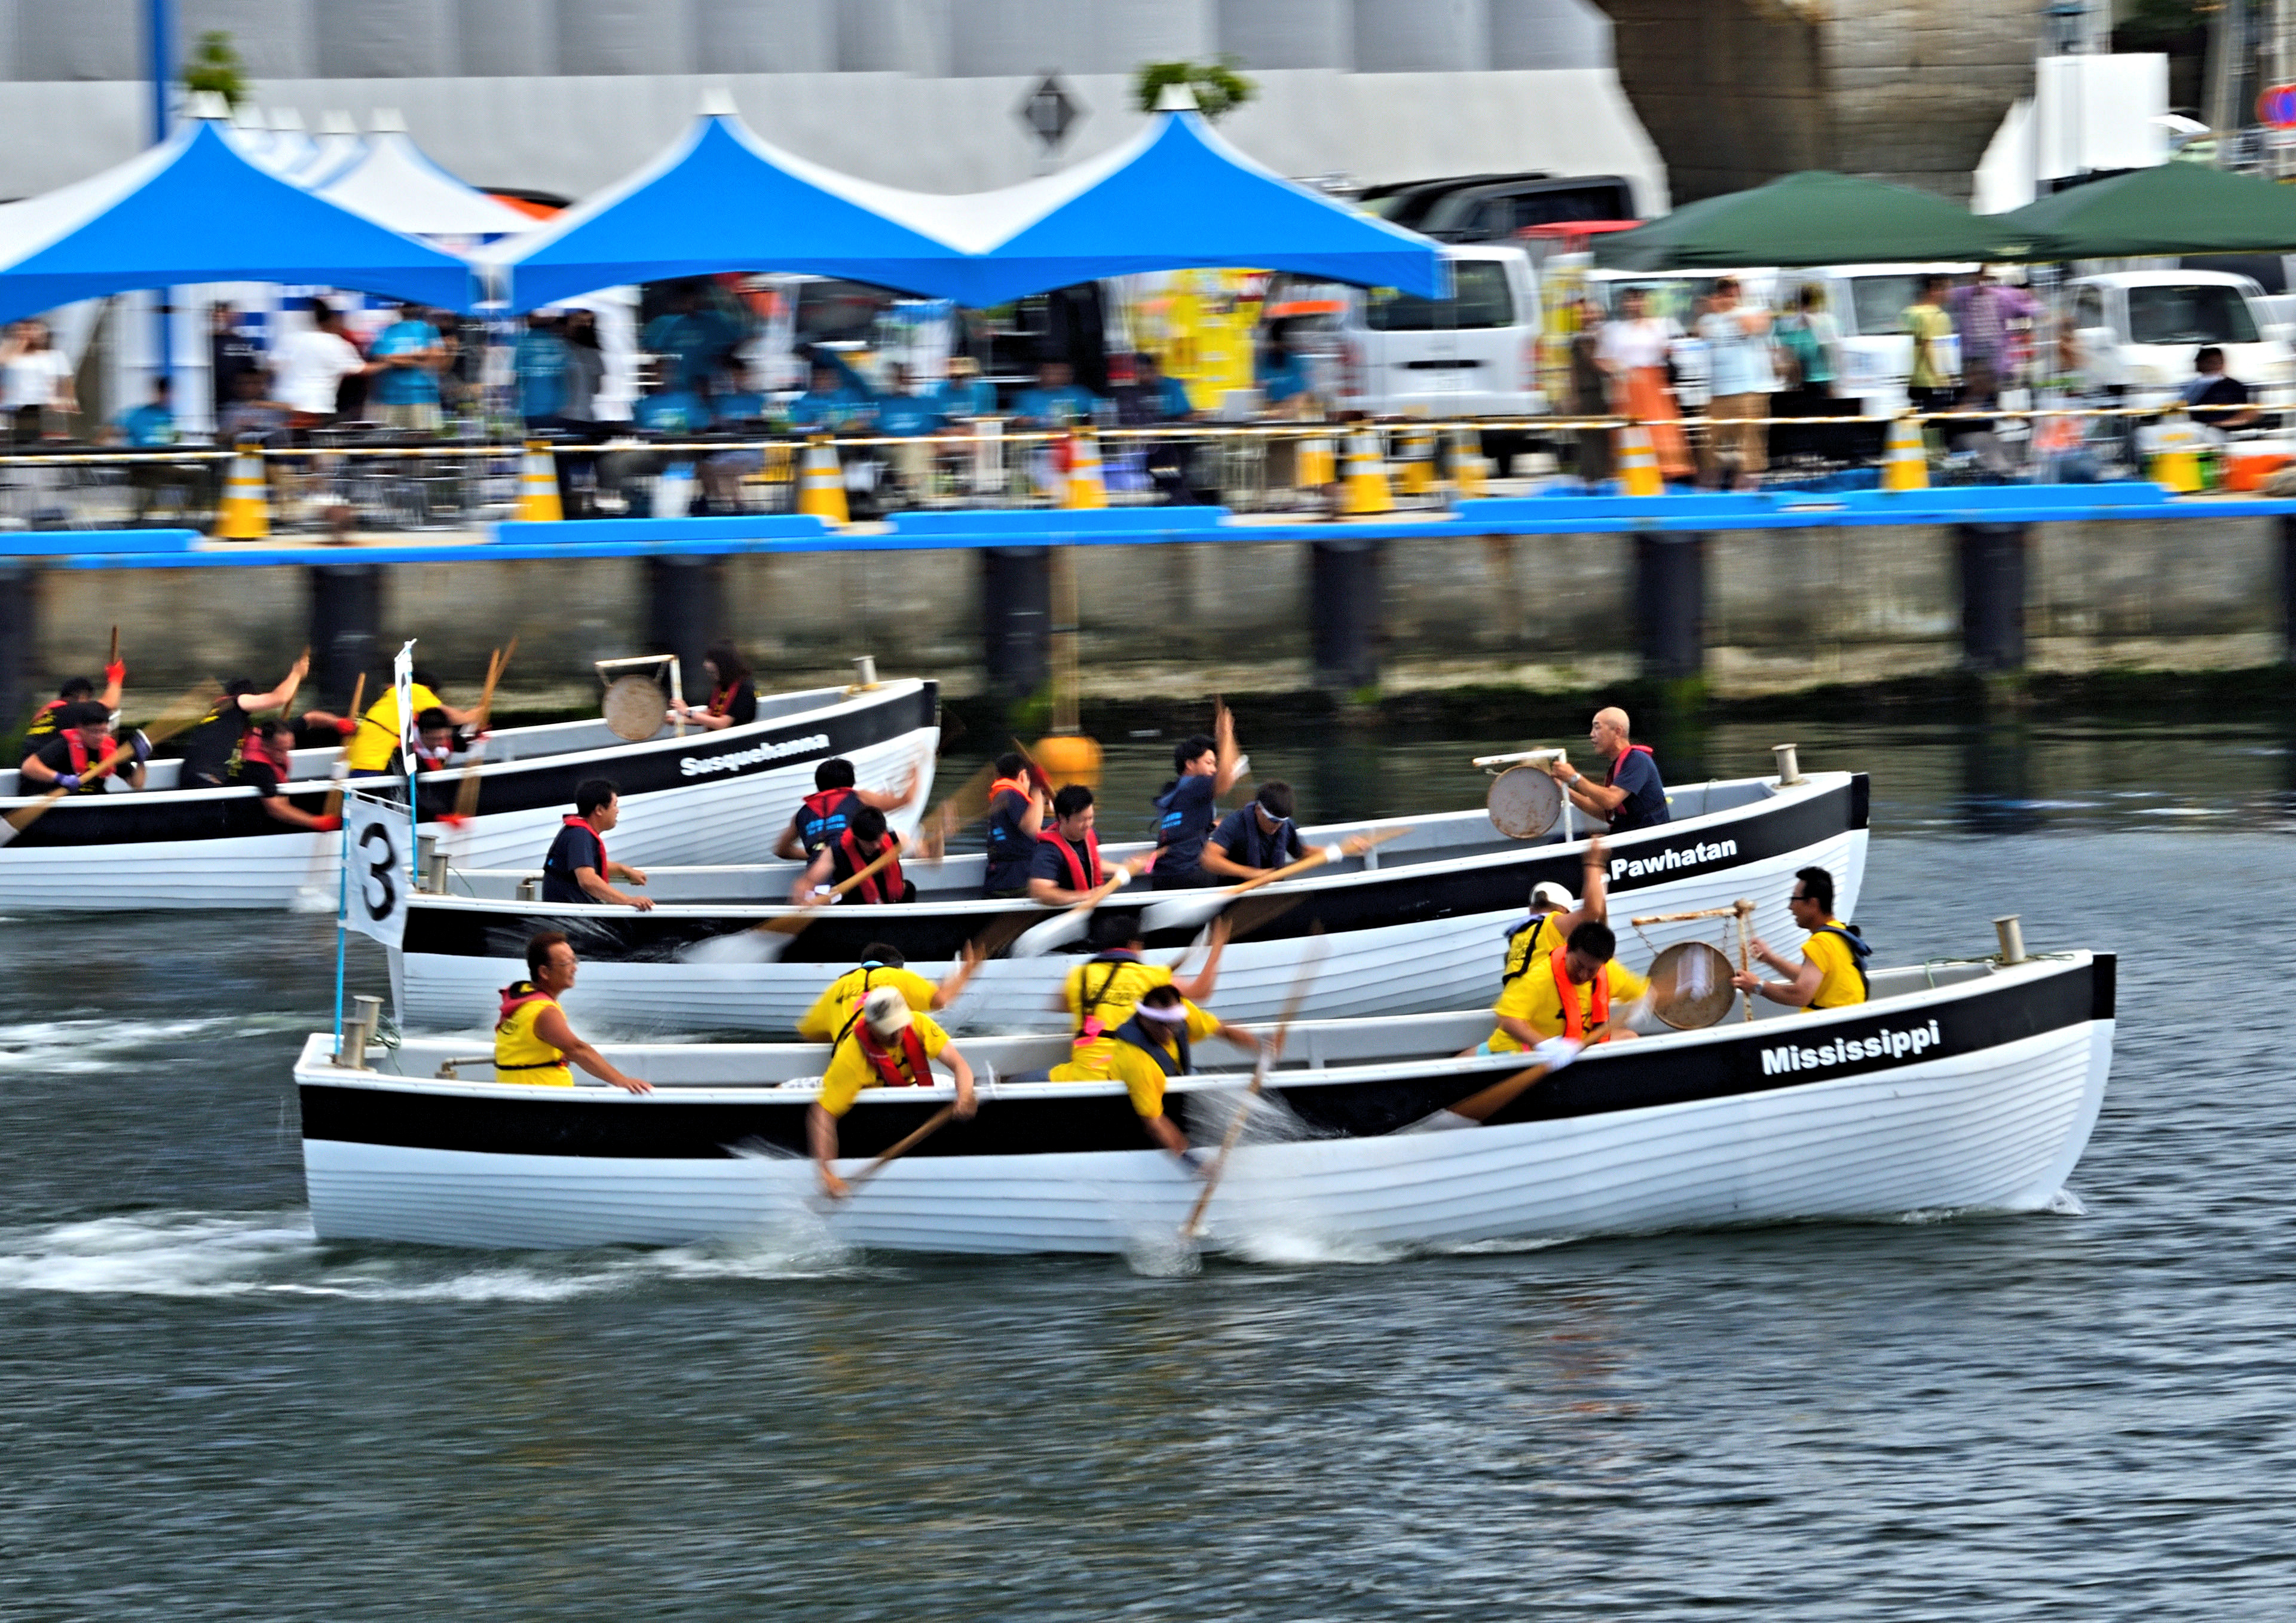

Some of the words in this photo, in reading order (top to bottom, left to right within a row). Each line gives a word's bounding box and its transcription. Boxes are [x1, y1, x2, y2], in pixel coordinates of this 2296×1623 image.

[359, 822, 396, 921] 3
[1611, 840, 1737, 880] Pawhatan
[1761, 1019, 1940, 1075] Mississippi
